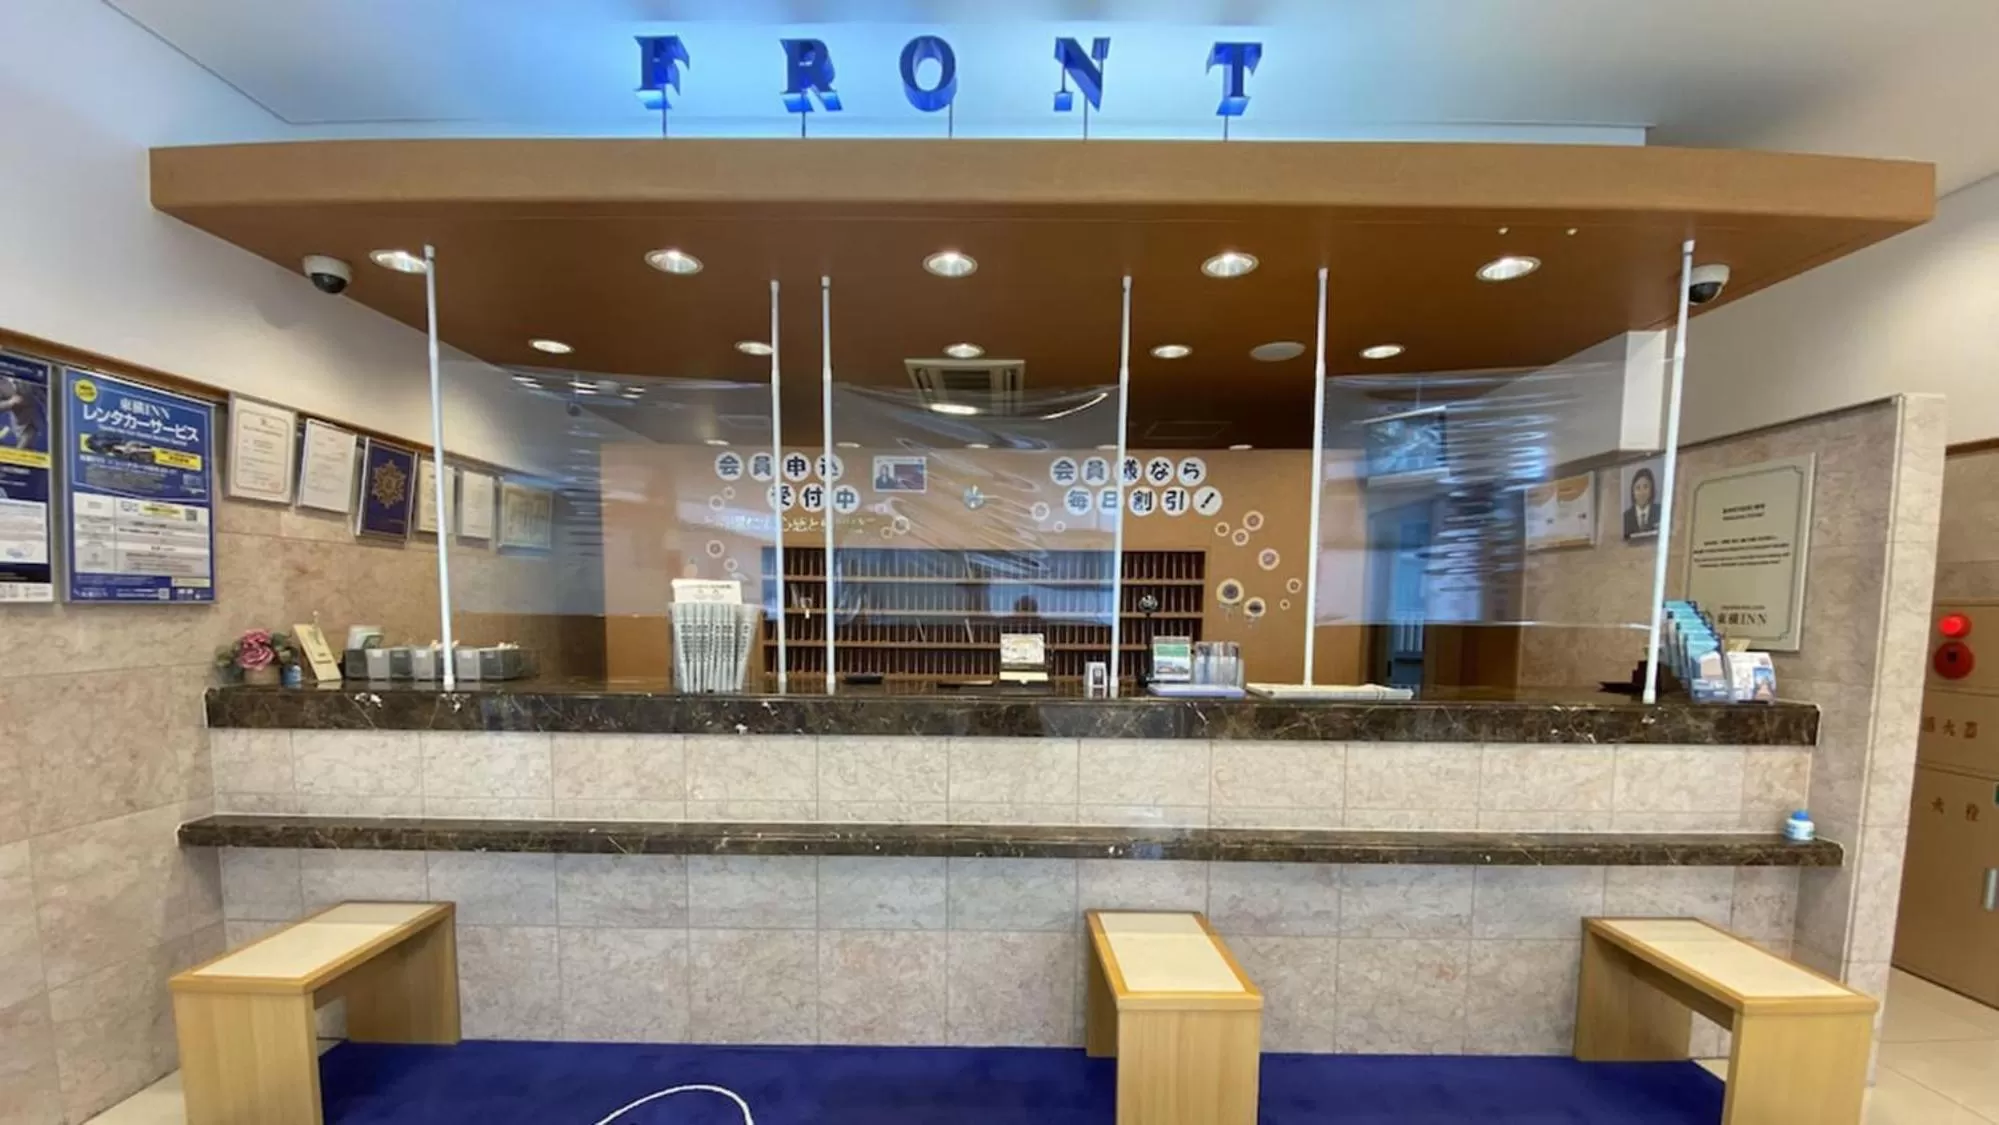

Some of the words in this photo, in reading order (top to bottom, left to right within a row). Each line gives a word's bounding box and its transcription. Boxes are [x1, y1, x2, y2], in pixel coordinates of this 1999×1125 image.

[634, 35, 1264, 116] FRONT
[83, 403, 200, 442] レンタカーサービス
